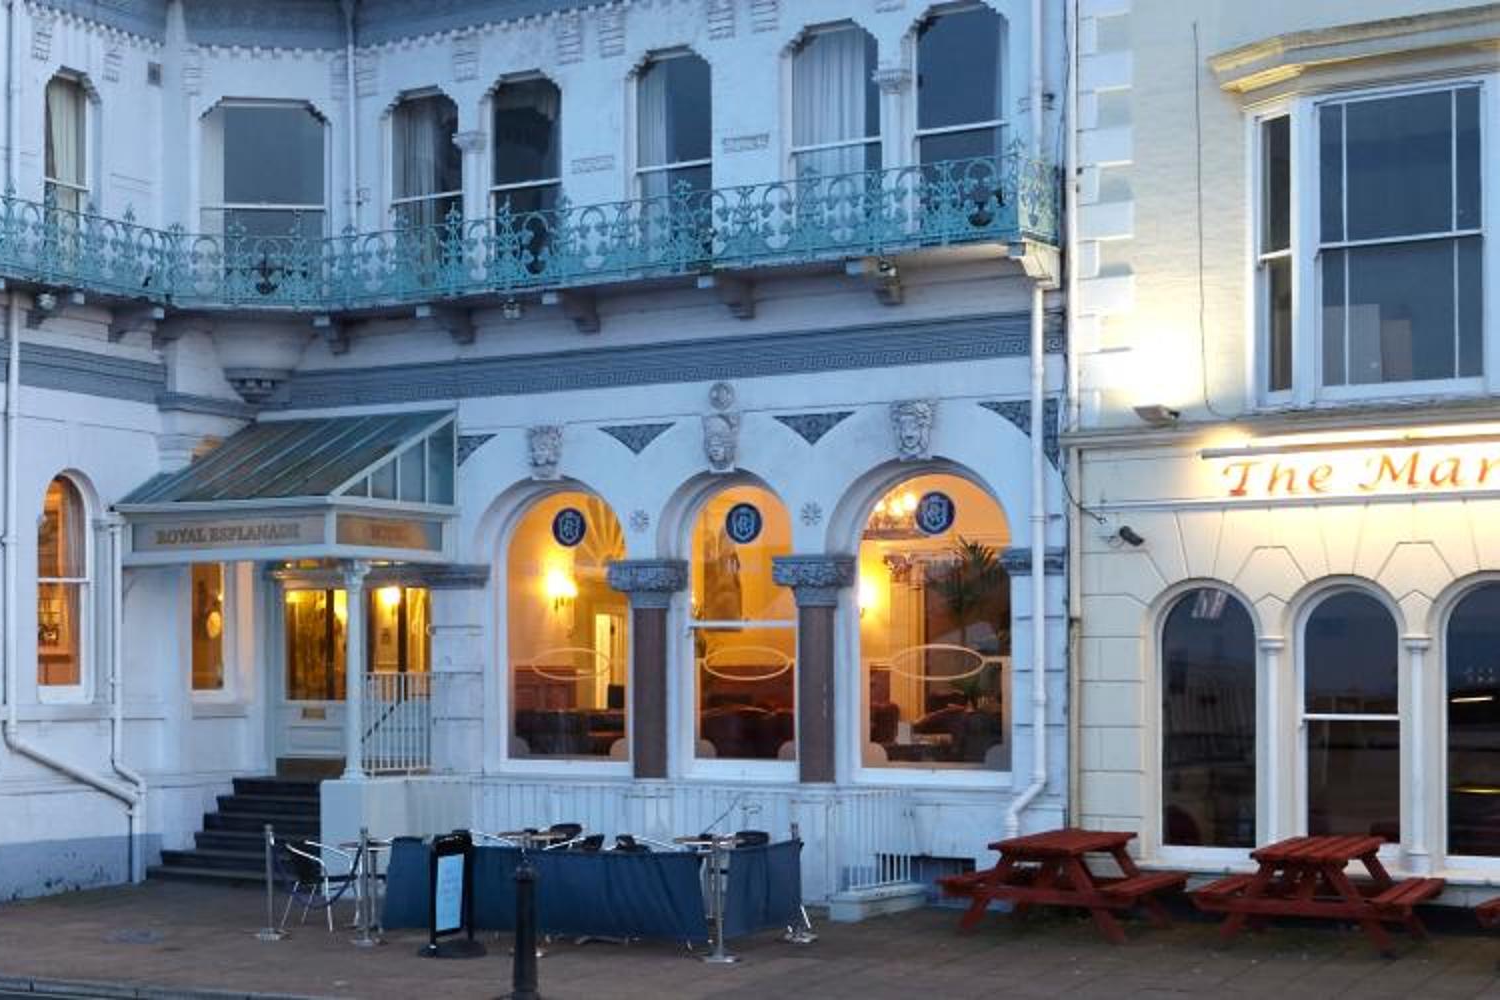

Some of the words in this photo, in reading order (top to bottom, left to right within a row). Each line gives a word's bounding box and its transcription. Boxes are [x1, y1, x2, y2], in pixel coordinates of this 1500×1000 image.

[1222, 461, 1333, 497] The
[156, 526, 207, 545] ROYAL
[209, 522, 300, 542] ESPLANADE
